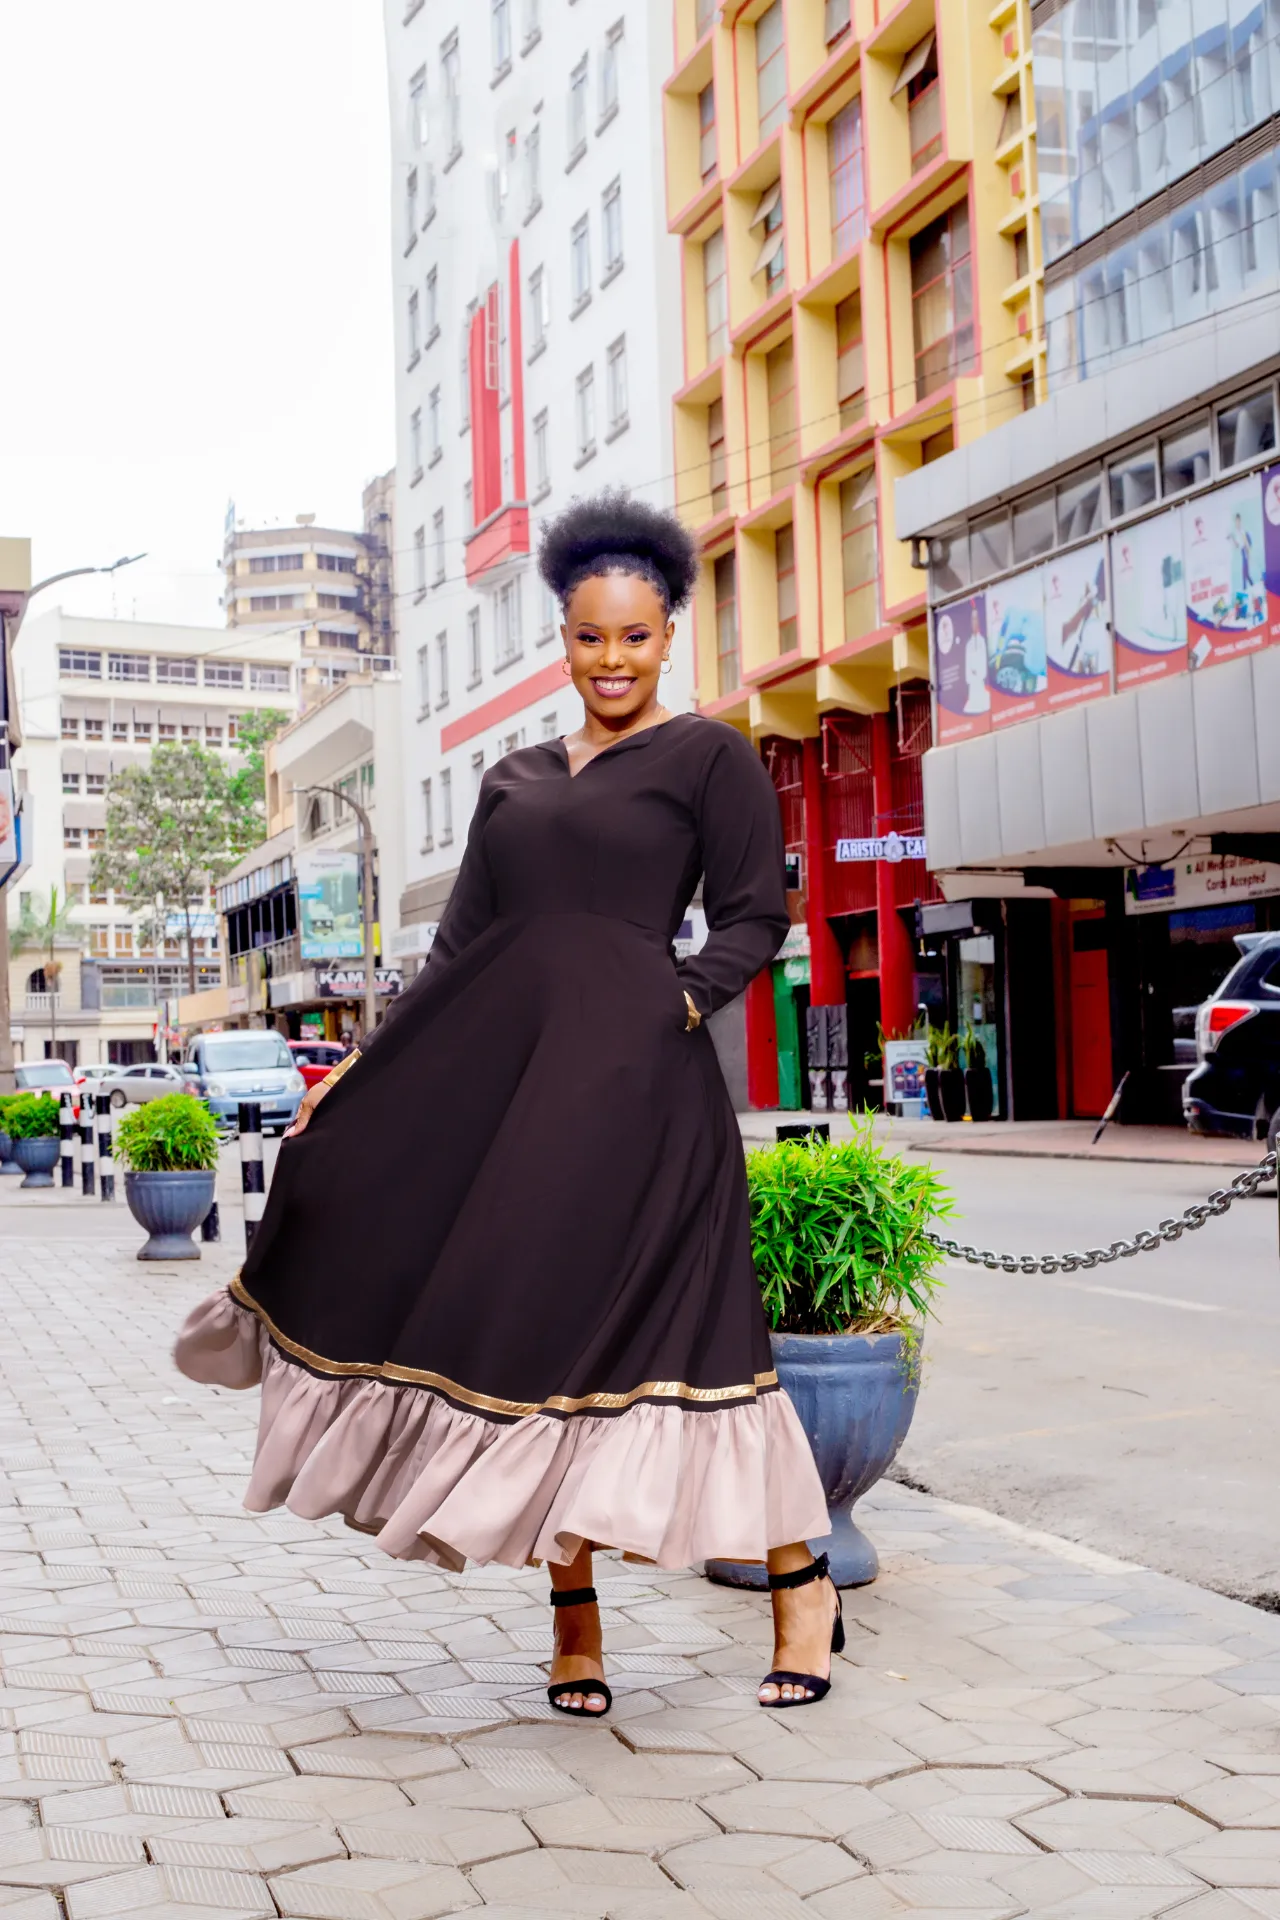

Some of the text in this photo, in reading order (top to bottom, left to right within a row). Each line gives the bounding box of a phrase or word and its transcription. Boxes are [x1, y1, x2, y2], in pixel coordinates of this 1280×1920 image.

[841, 841, 883, 859] ARISTO
[1207, 857, 1237, 871] Medical
[1206, 870, 1266, 891] Cards Accepted
[320, 970, 401, 984] KAMTA
